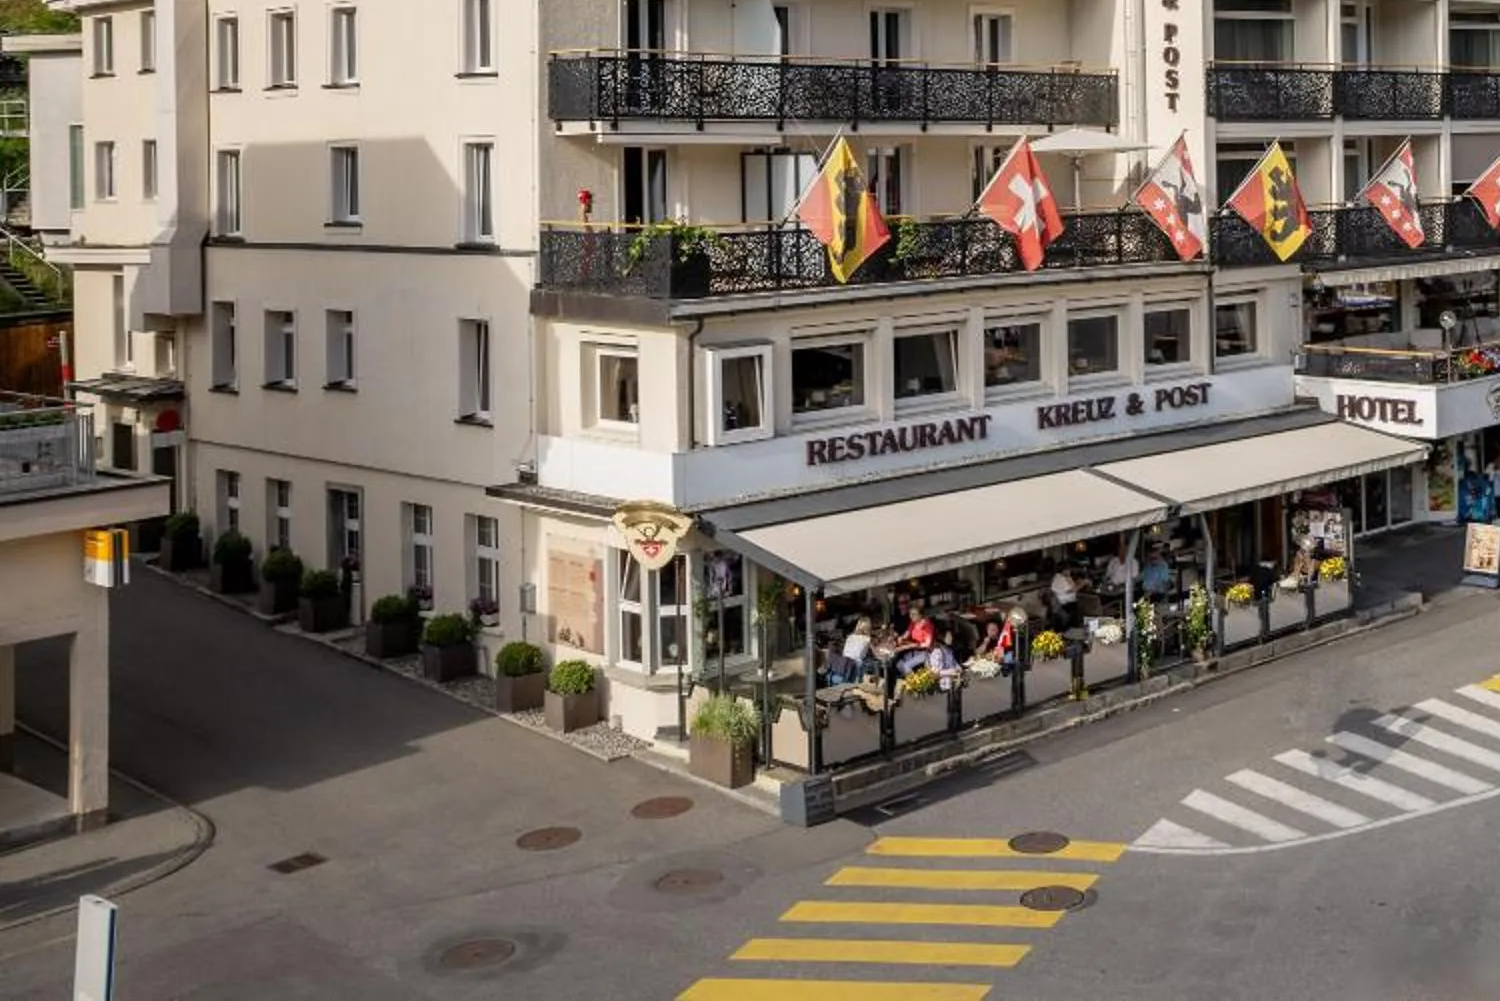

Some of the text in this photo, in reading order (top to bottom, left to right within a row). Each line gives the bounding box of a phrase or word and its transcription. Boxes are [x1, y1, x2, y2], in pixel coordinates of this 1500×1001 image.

[1163, 22, 1181, 114] POST
[806, 382, 1212, 466] RESTAURANT KREUZ & POST
[1336, 394, 1424, 425] HOTEL
